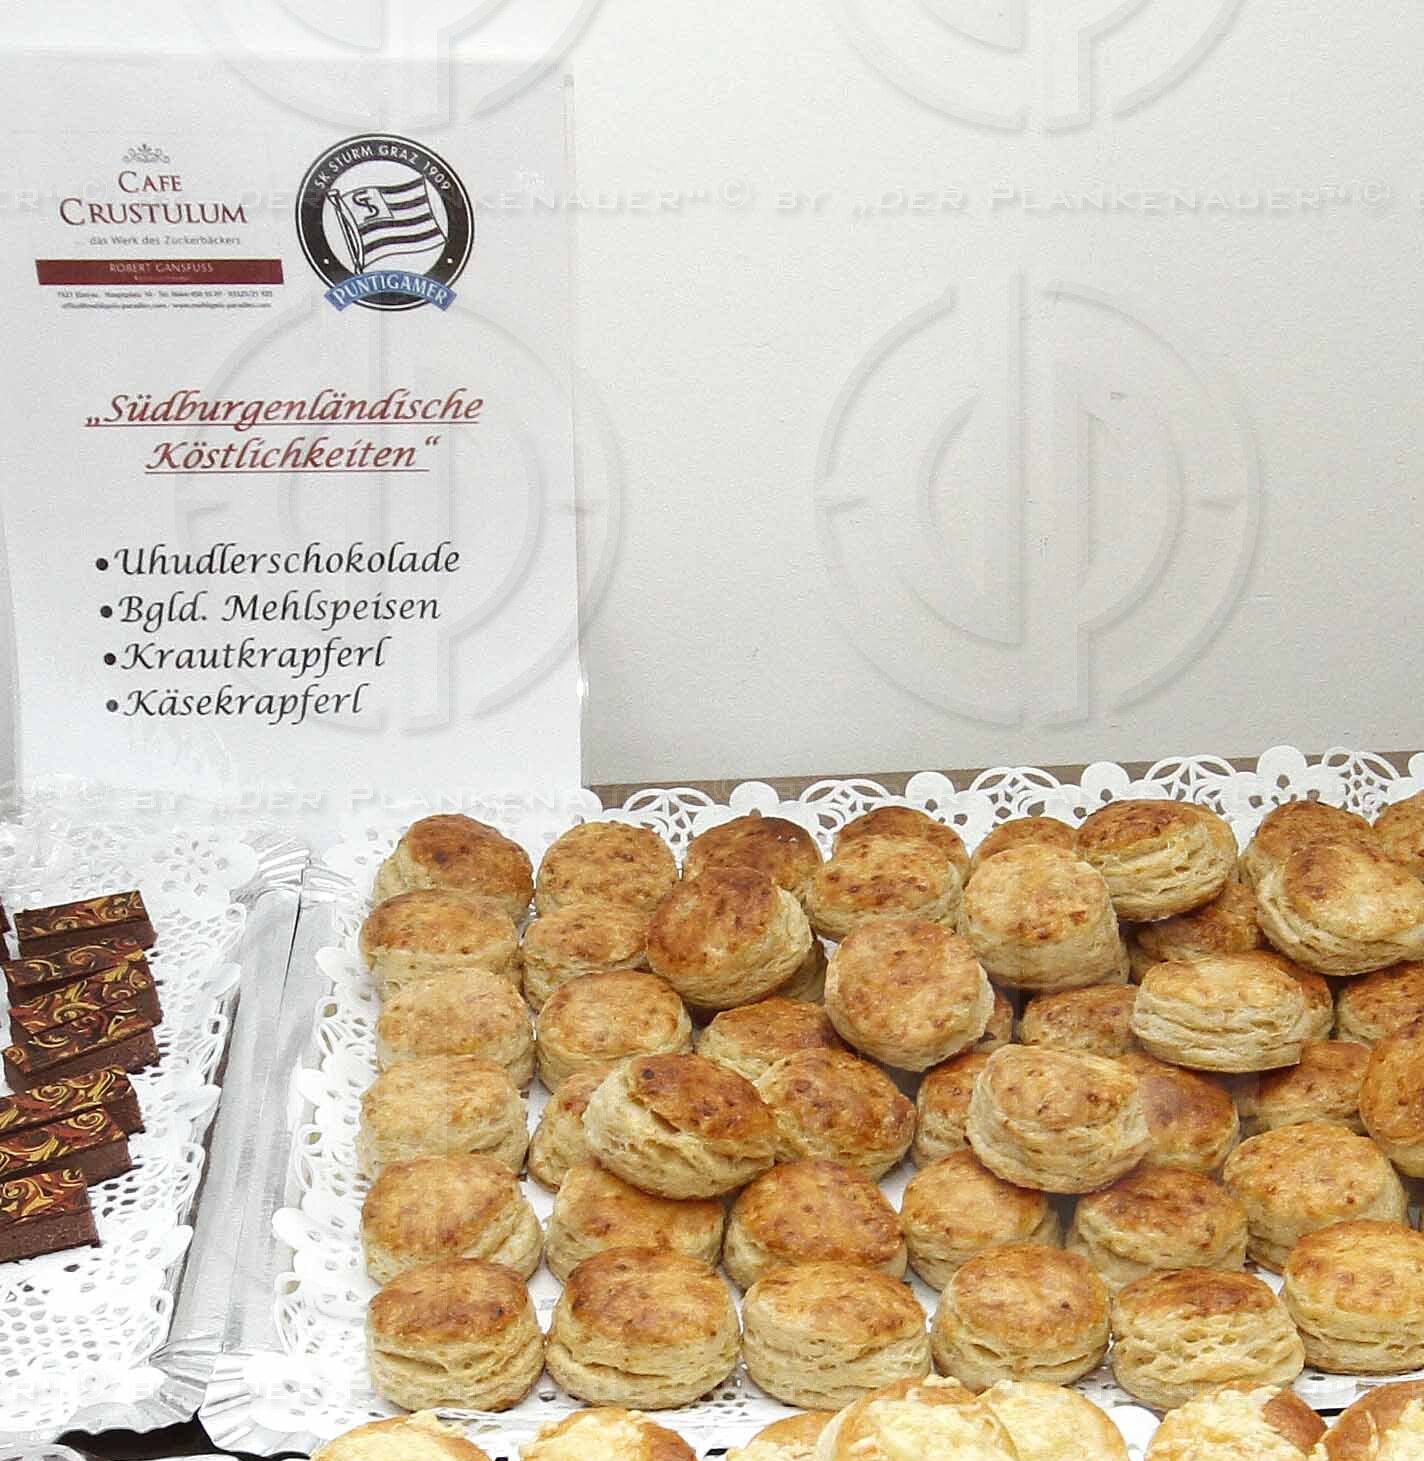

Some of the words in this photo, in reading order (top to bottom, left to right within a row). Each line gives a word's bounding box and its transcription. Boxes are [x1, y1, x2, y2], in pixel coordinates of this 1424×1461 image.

[314, 172, 333, 190] SK
[328, 144, 374, 174] STURM
[377, 144, 420, 166] GRAZ
[423, 160, 453, 191] 1909
[59, 198, 248, 225] CRUSTULUM
[332, 273, 449, 306] PUNTIGAMER
[113, 541, 461, 576] Uhudlerschokolade
[118, 591, 208, 633] Bgld.
[221, 589, 442, 632] Mehlspeisen
[121, 635, 393, 680] Krautkrapferl
[123, 682, 370, 726] Käsekrapferl
